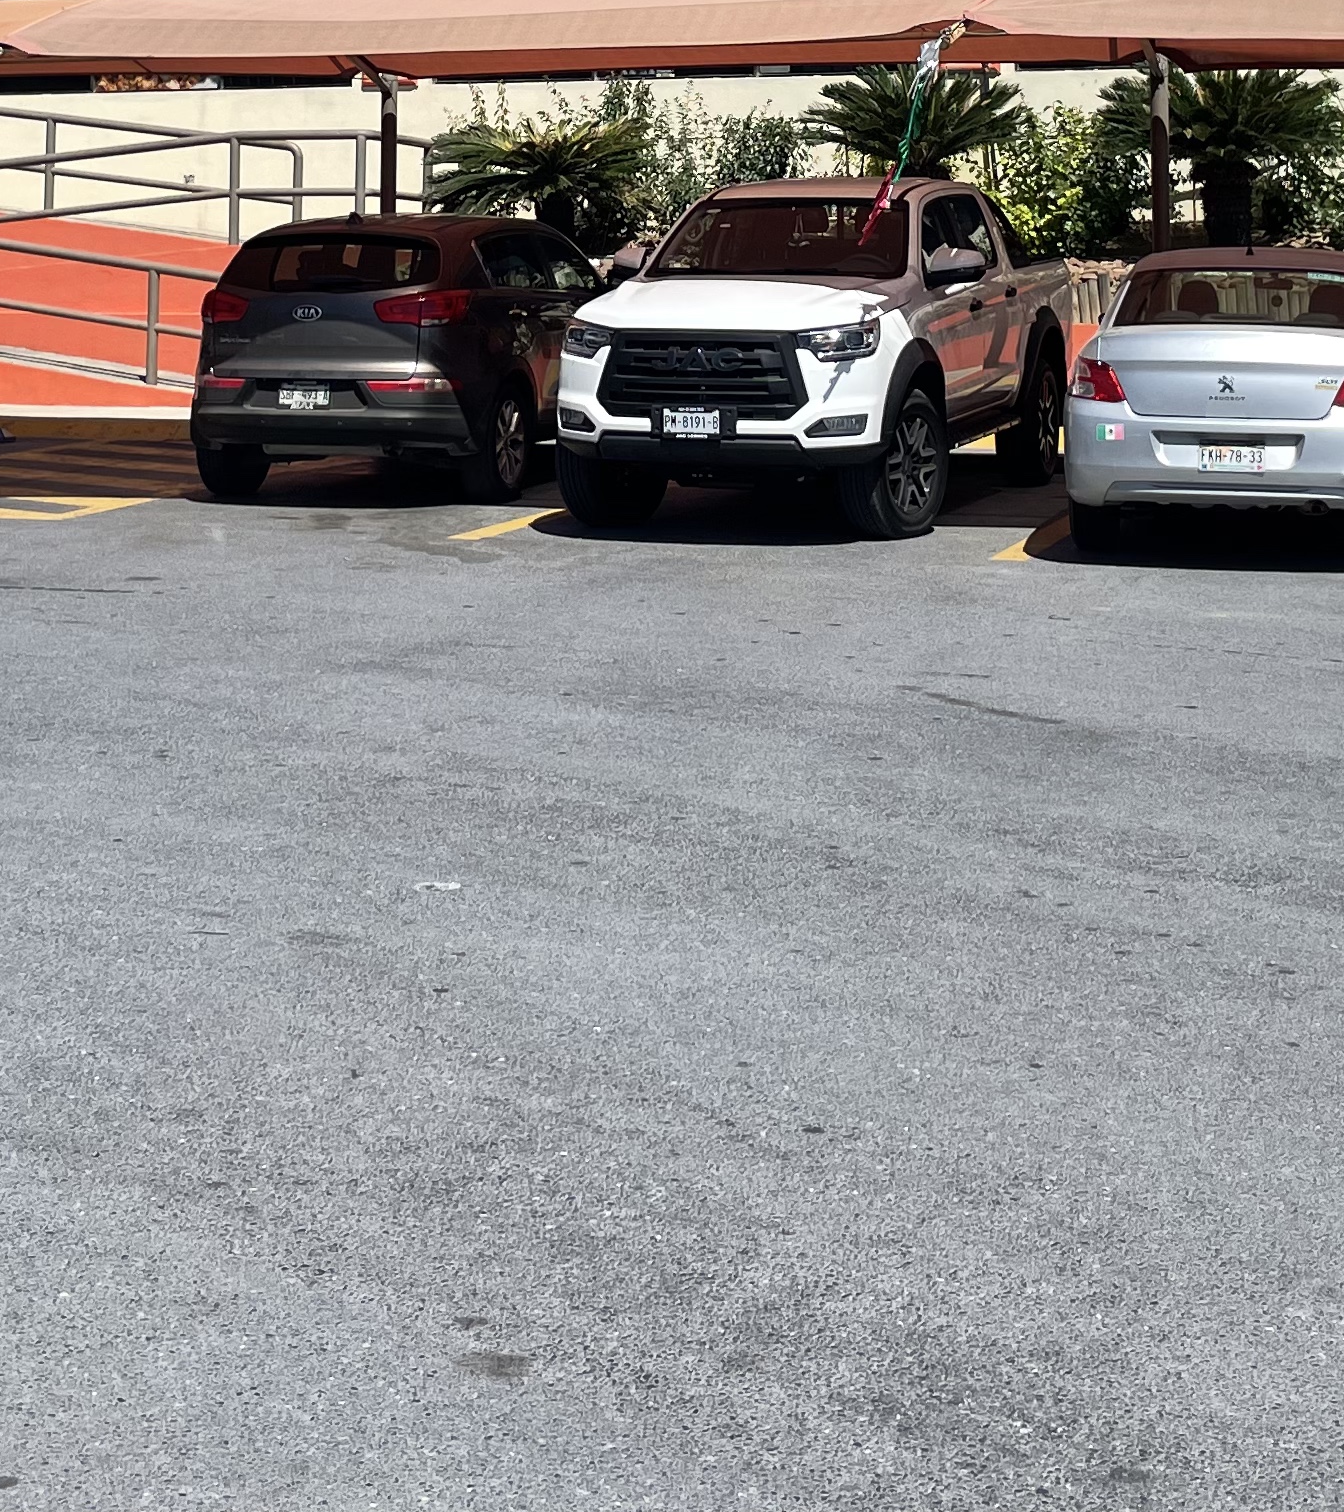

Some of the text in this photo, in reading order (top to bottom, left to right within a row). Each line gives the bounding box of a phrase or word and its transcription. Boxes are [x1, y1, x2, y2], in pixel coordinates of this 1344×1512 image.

[296, 307, 317, 318] KIA
[651, 346, 744, 372] JAC
[1200, 449, 1263, 464] FKH-78-33
